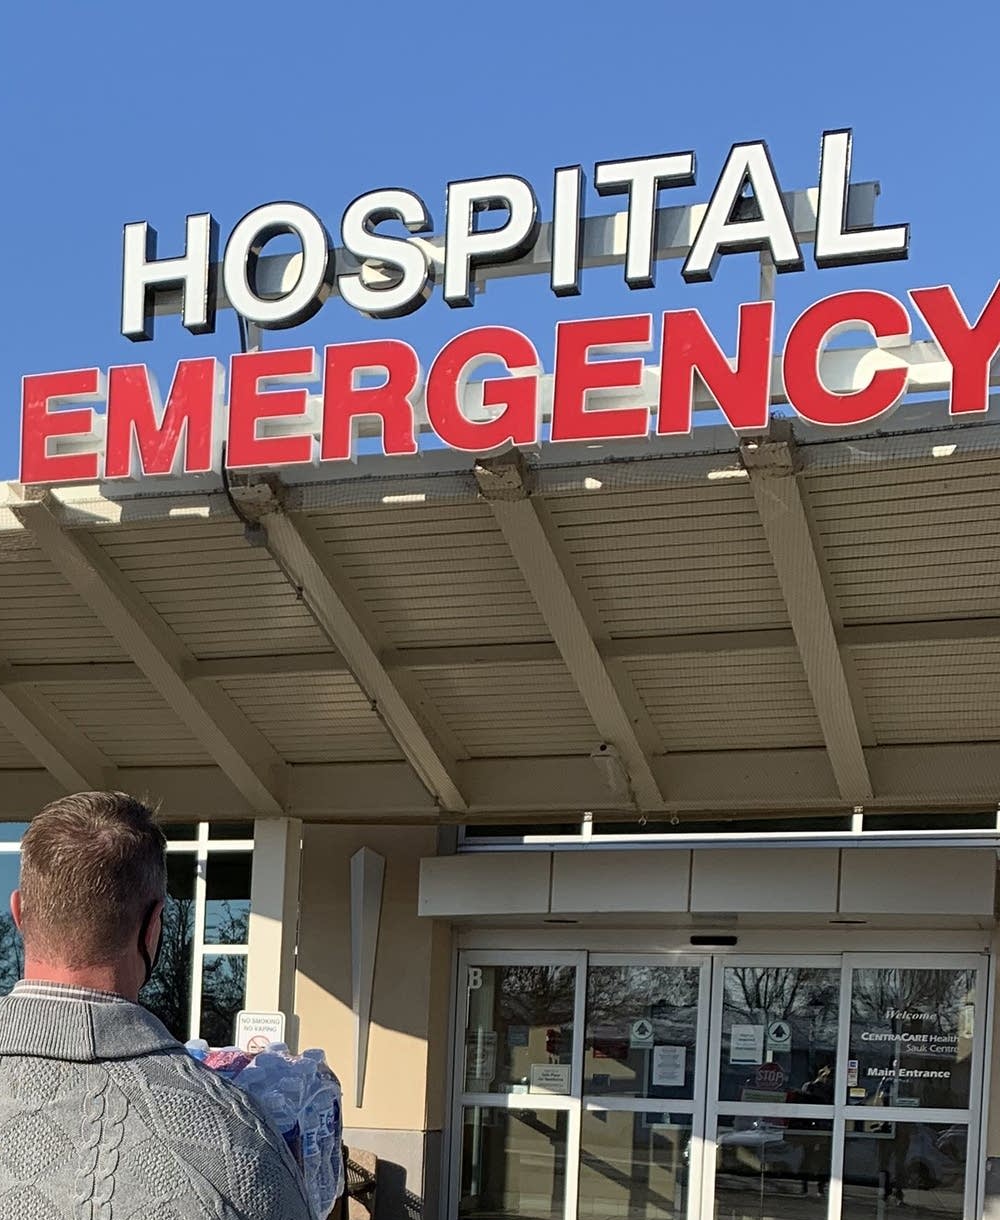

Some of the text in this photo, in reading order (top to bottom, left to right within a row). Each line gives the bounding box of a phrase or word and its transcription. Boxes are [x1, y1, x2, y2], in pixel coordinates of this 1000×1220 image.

[121, 129, 909, 341] HOSPITAL
[19, 278, 1000, 484] EMERGENCY
[885, 1009, 937, 1020] Welcome
[252, 1017, 280, 1025] SMOKING
[861, 1032, 960, 1043] CENTRACARE Health
[906, 1043, 928, 1053] Sauk
[756, 1069, 784, 1083] STOP
[867, 1067, 951, 1078] Main Entrance
